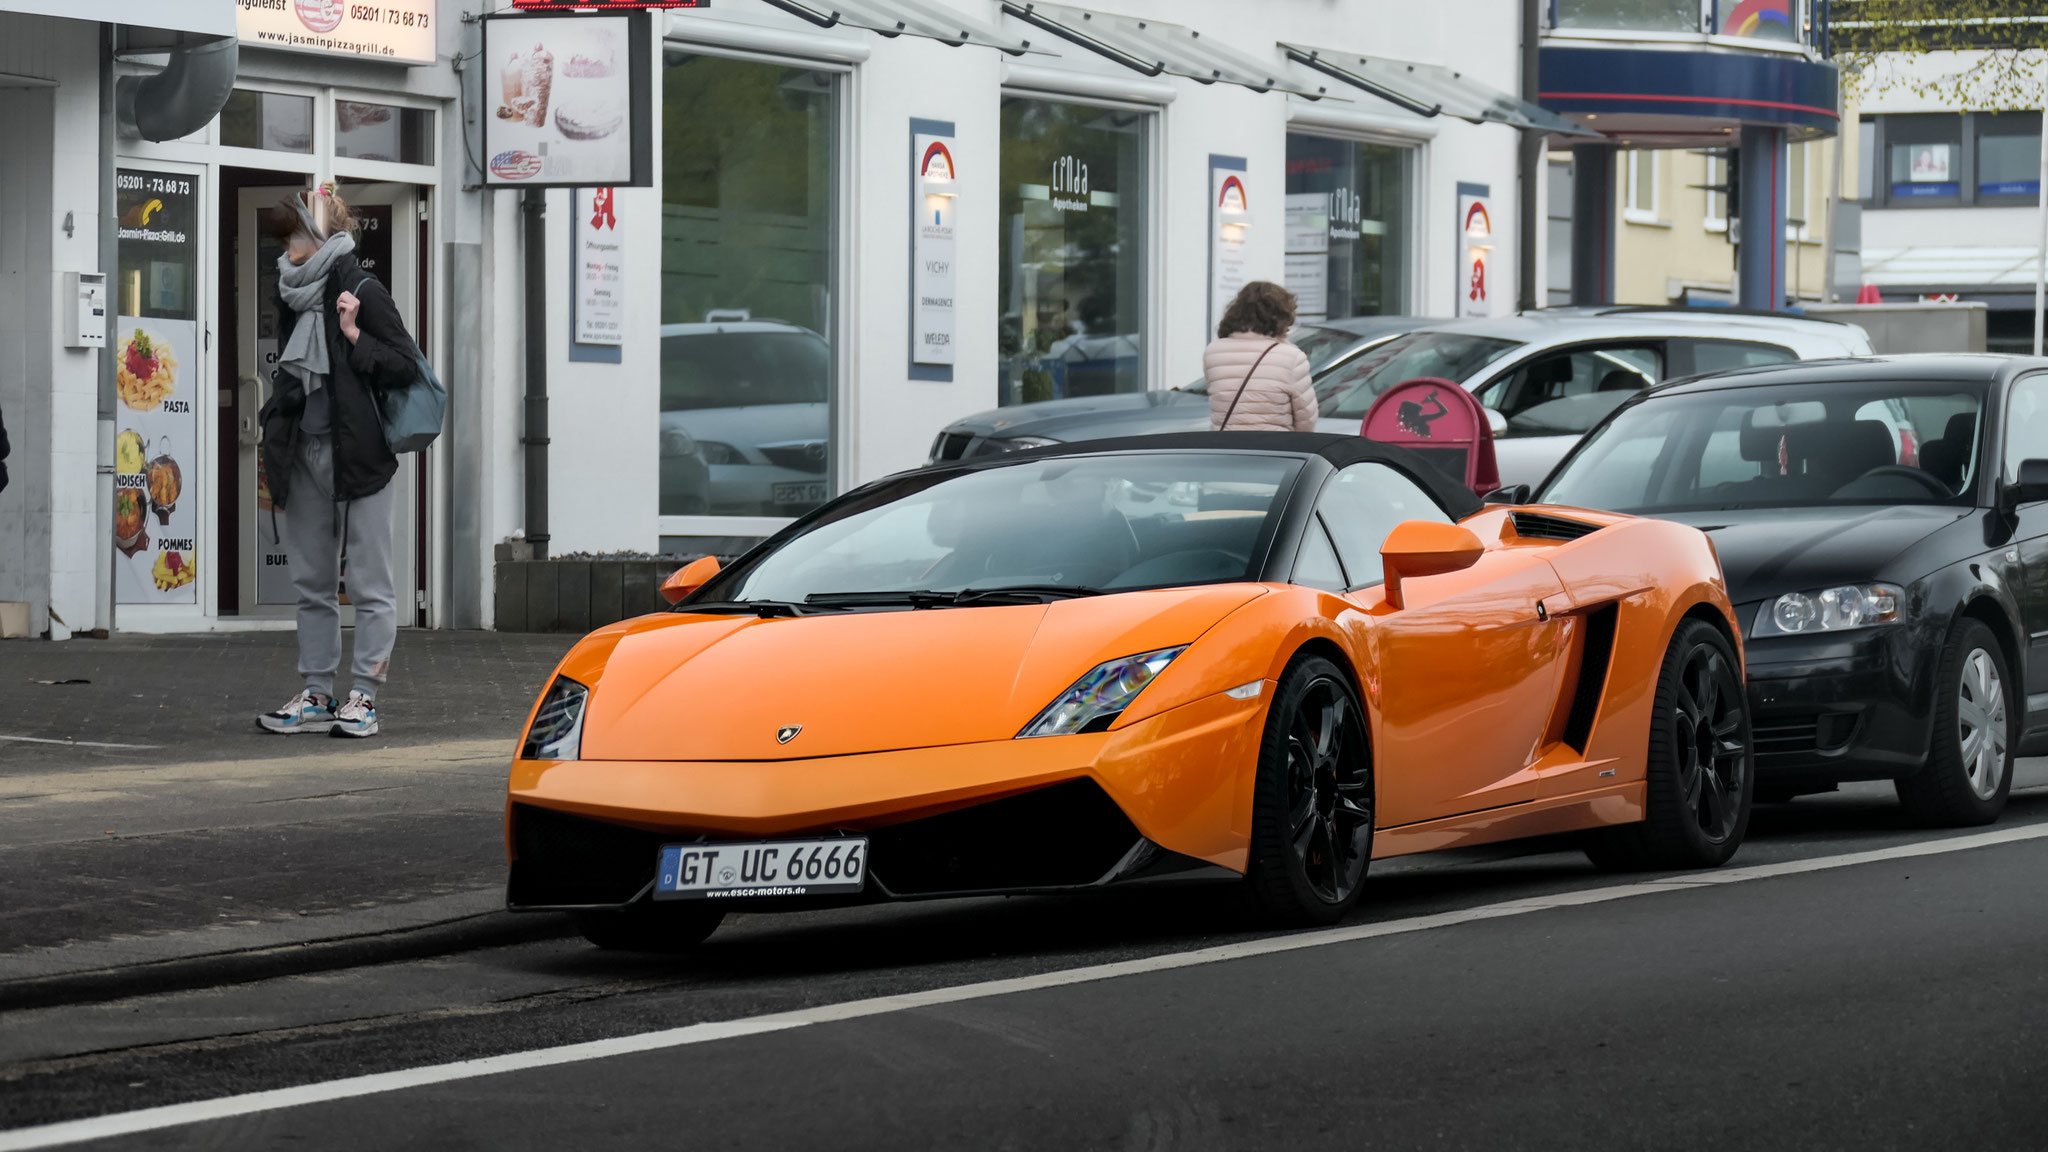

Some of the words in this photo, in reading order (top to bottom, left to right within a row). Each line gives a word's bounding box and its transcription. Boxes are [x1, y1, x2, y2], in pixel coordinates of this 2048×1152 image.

[236, 0, 286, 10] ngdienst
[351, 4, 379, 22] 05201
[388, 9, 400, 25] 73
[402, 11, 414, 27] 68
[417, 13, 429, 28] 73
[257, 31, 395, 56] www.jasminpizzagrill.de
[117, 174, 143, 189] 05201
[152, 178, 163, 192] 73
[165, 179, 177, 194] 68
[178, 181, 190, 195] 73
[1053, 197, 1088, 212] Apotheken
[61, 210, 75, 239] 4
[363, 218, 378, 230] 73
[926, 261, 949, 274] VICHY
[922, 296, 953, 307] DERMASENCE
[925, 332, 950, 345] WELEDA
[164, 400, 190, 413] PASTA
[116, 474, 145, 488] NDISCH
[158, 538, 193, 551] POMMES
[680, 850, 719, 885] GT
[740, 848, 779, 883] UC
[786, 845, 861, 880] 6666
[664, 874, 672, 885] D
[706, 886, 806, 898] www.esco-motors.de
